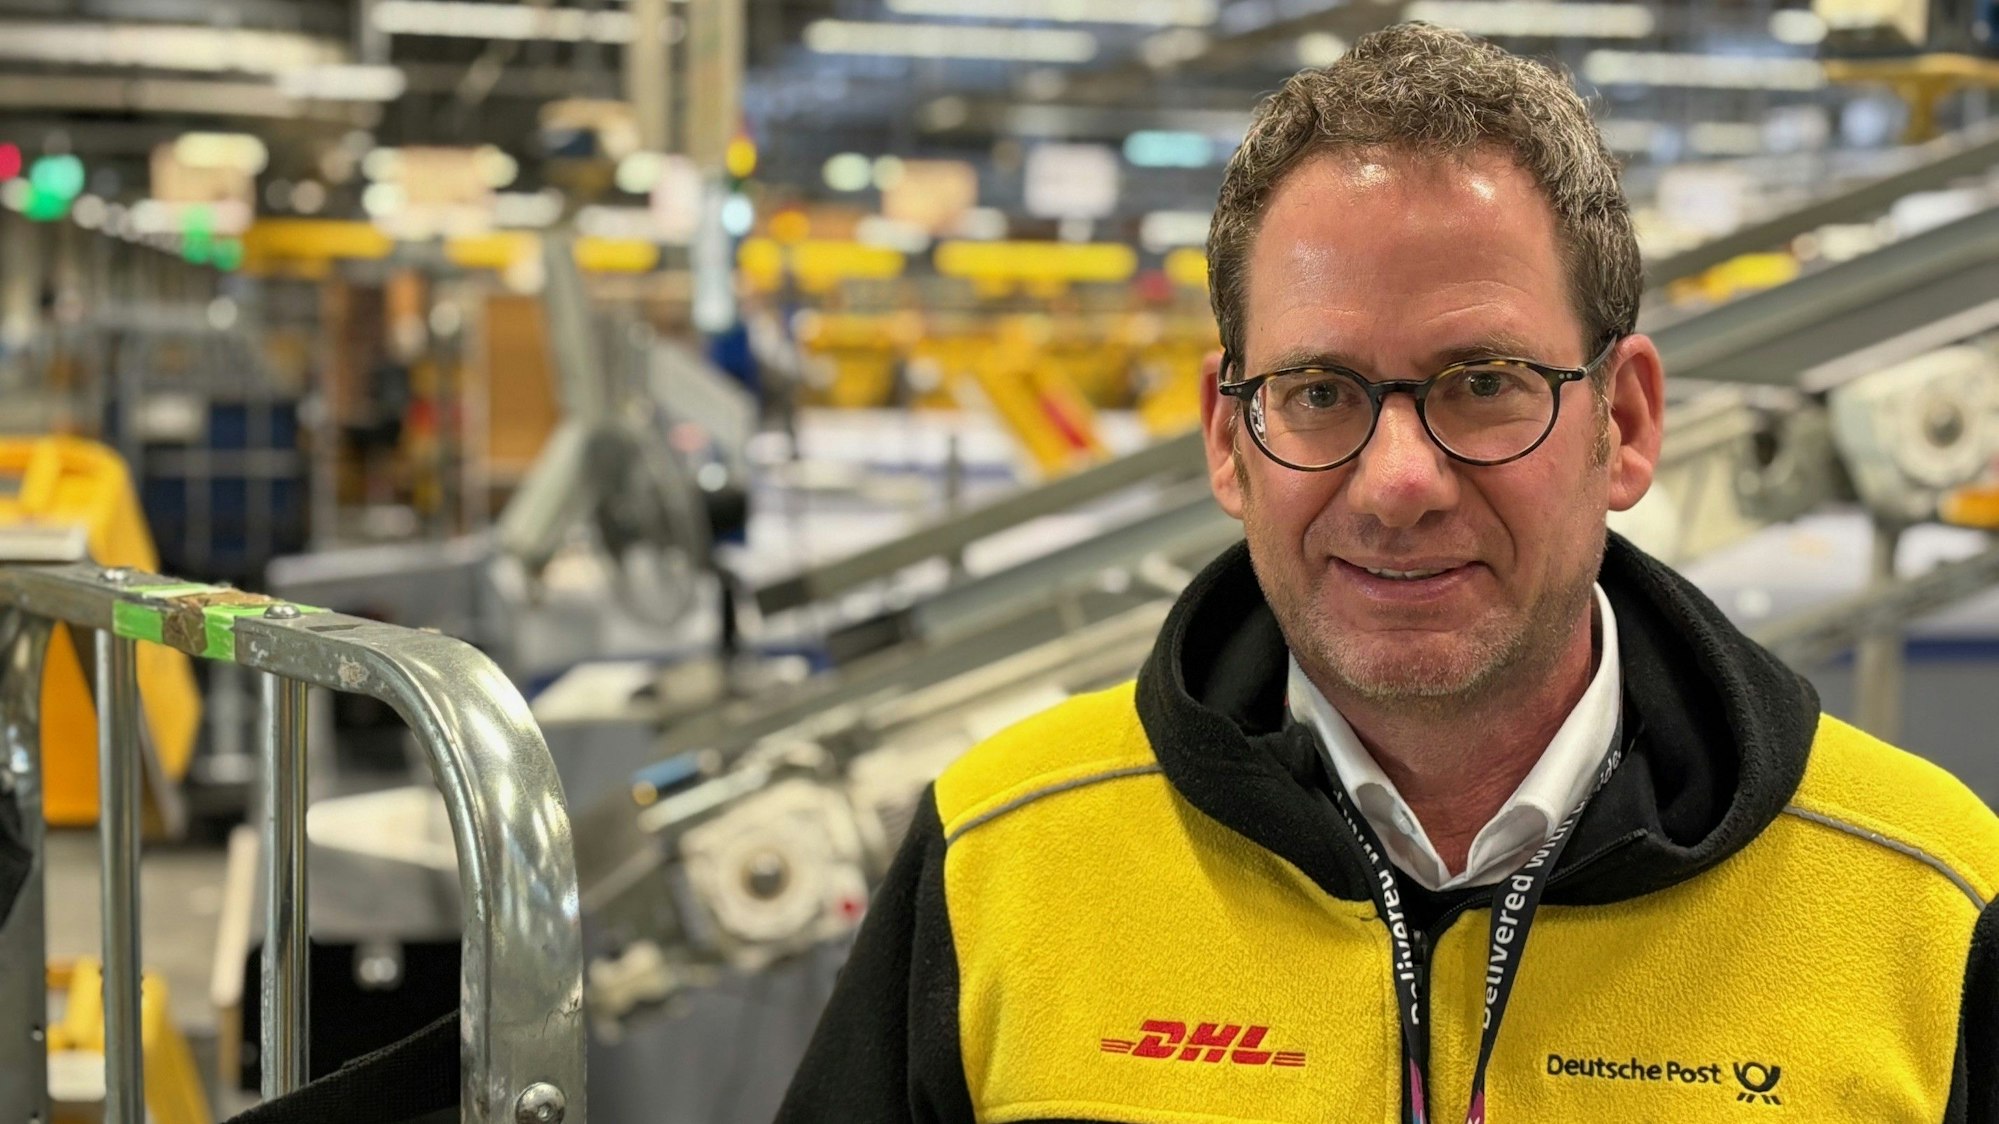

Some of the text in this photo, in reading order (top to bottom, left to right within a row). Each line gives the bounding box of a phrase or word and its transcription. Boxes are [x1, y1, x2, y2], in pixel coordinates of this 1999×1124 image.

[1132, 1019, 1272, 1065] DHL
[1547, 1054, 1722, 1084] Deutsche Post
